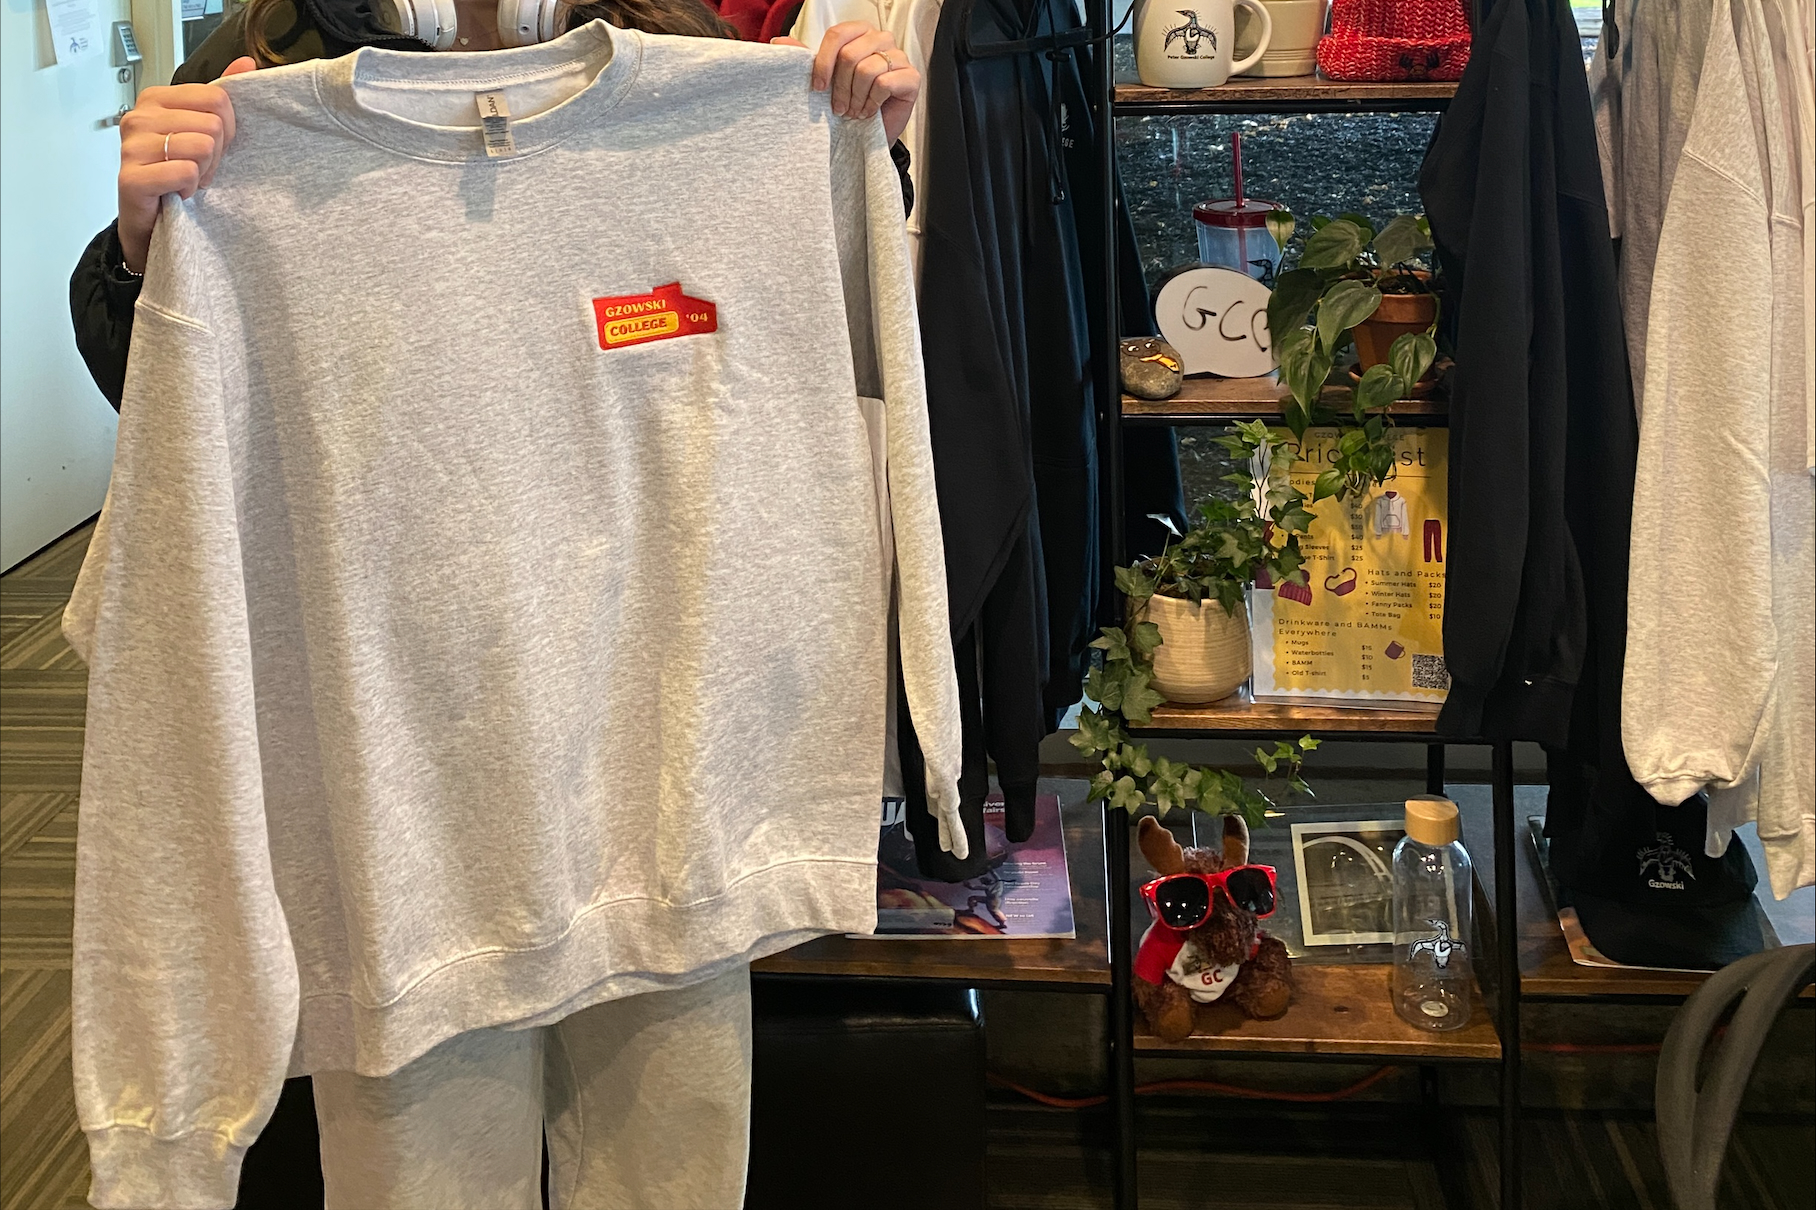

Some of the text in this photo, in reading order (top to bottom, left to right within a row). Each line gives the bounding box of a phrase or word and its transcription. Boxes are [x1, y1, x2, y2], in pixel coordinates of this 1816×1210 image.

[605, 299, 666, 317] GZOWSKI
[610, 318, 667, 336] COLLEGE
[1287, 442, 1341, 464] Pric
[1367, 569, 1446, 578] Hats and Packs
[1371, 579, 1400, 587] Summer
[1371, 601, 1391, 609] Fanny
[1428, 602, 1442, 610] $20
[1278, 618, 1330, 627] Drinkware
[1356, 622, 1393, 631] BAMMs
[1278, 628, 1337, 637] Everywhere
[1648, 878, 1685, 891] Gzowski
[1201, 968, 1224, 986] GC
